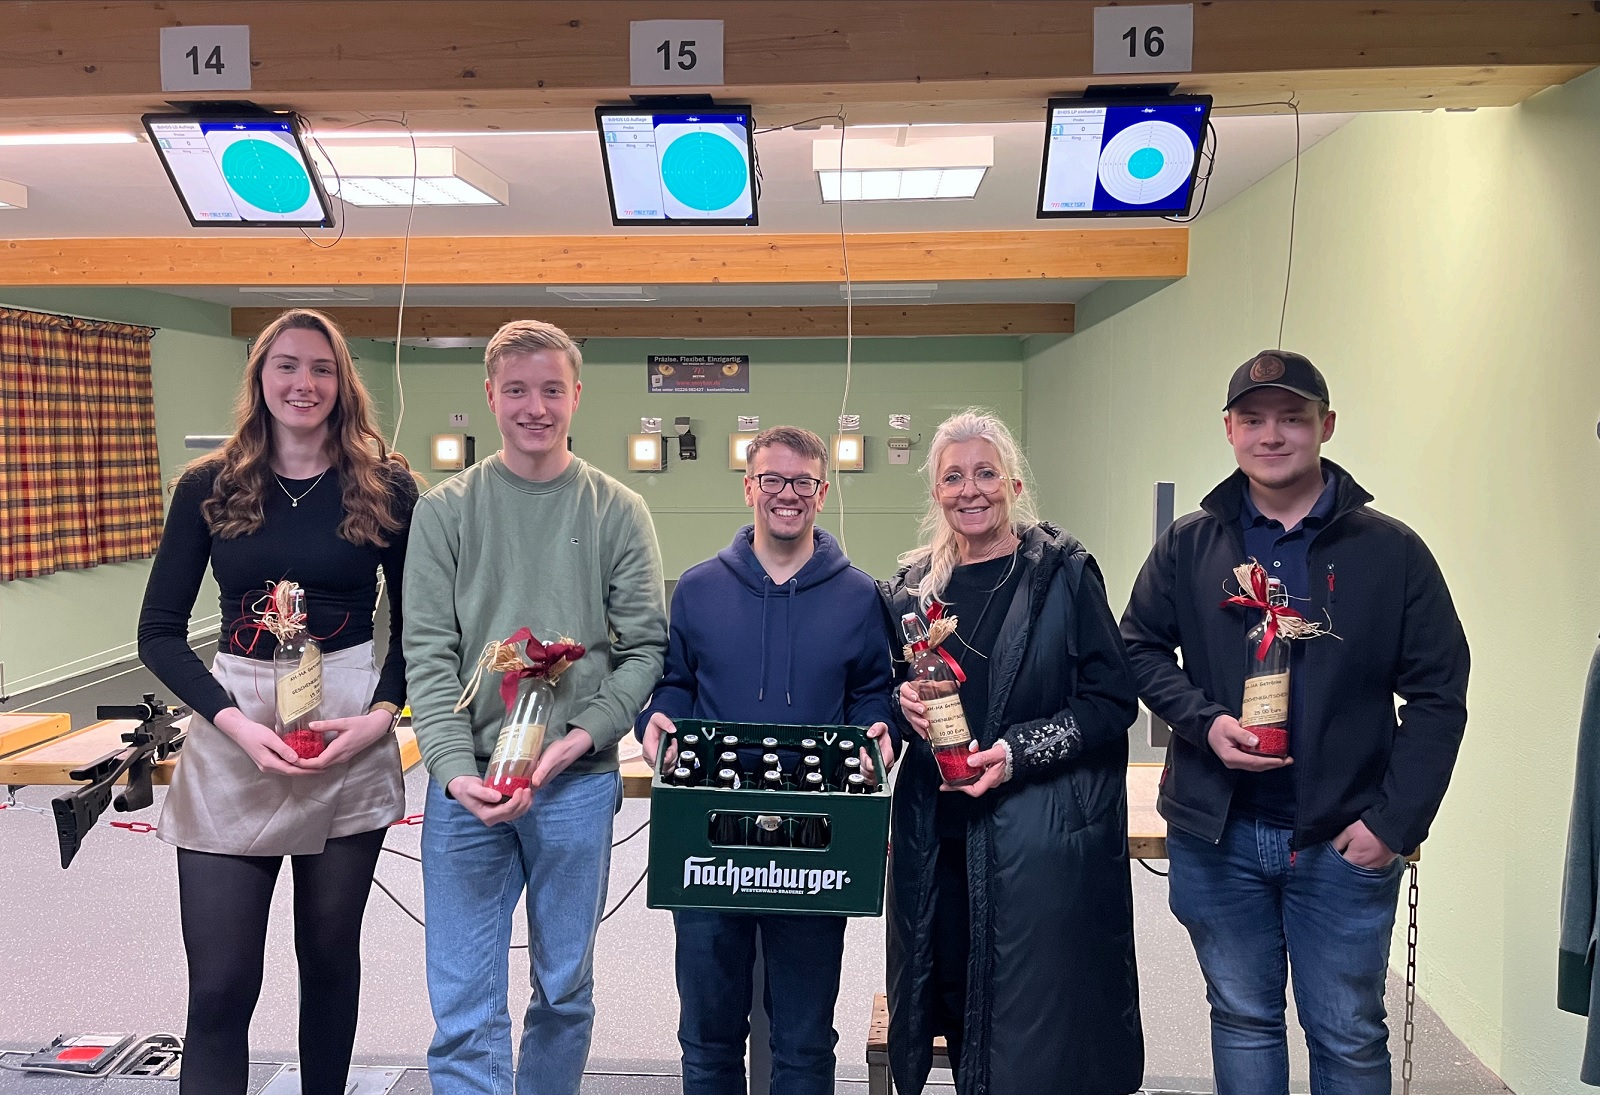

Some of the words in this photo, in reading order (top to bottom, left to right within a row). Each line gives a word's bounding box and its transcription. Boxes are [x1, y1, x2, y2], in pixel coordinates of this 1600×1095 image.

[656, 40, 698, 70] 15
[1122, 26, 1165, 58] 16
[185, 45, 226, 75] 14
[684, 856, 848, 895] Hachenburger
